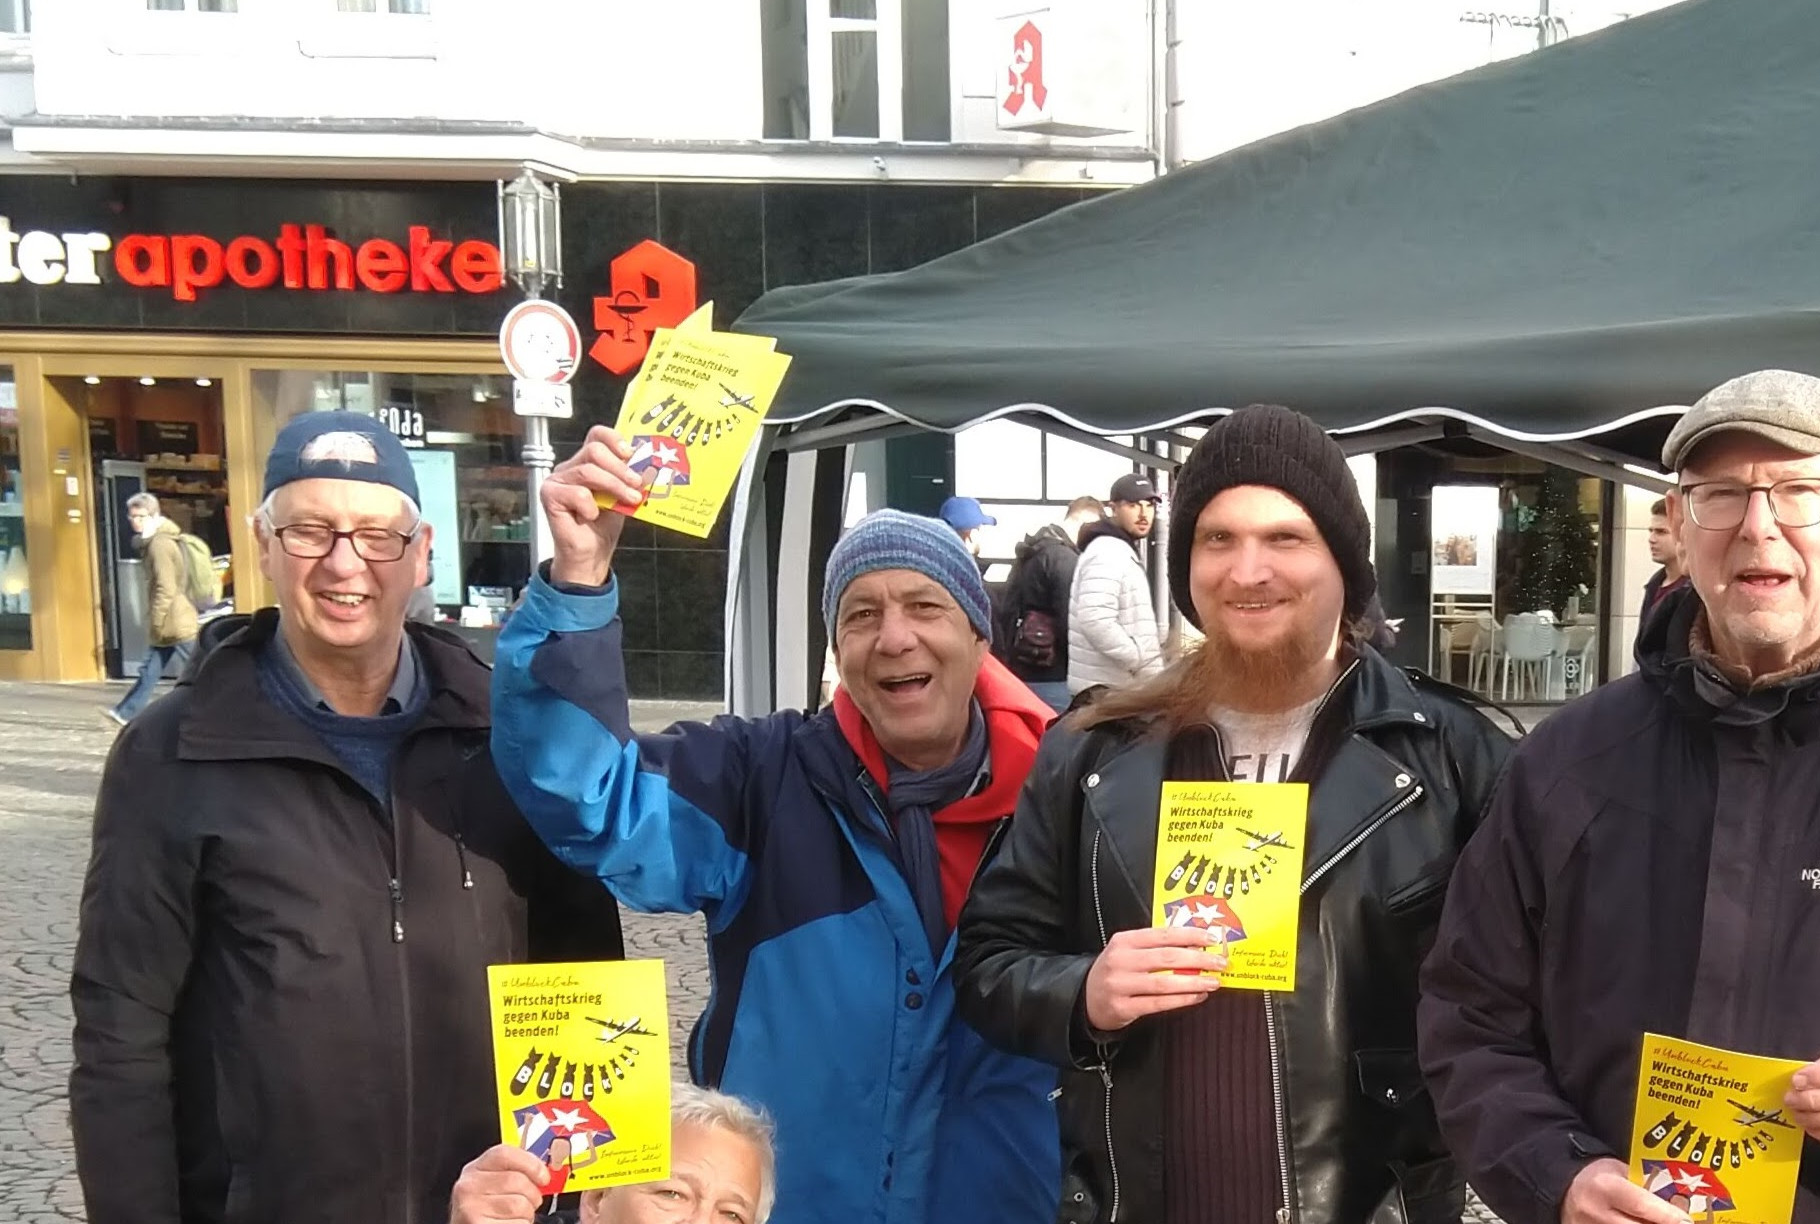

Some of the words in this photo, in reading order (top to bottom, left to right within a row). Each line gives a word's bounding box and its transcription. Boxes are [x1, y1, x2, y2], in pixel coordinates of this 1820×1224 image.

[114, 223, 506, 301] apotheke
[665, 363, 691, 376] gegen
[1170, 806, 1253, 819] Wirtschaftskrieg
[1167, 820, 1198, 831] gegen
[1199, 820, 1224, 831] Kuba
[1167, 832, 1213, 843] beenden!
[503, 993, 602, 1006] Wirtschaftskrieg
[503, 1011, 538, 1024] gegen
[541, 1009, 570, 1021] Kuba
[505, 1025, 559, 1037] beenden!
[1652, 1060, 1749, 1093] Wirtschaftskrieg
[1648, 1074, 1683, 1091] gegen
[1685, 1083, 1714, 1099] Kuba
[1648, 1087, 1701, 1110] beenden!
